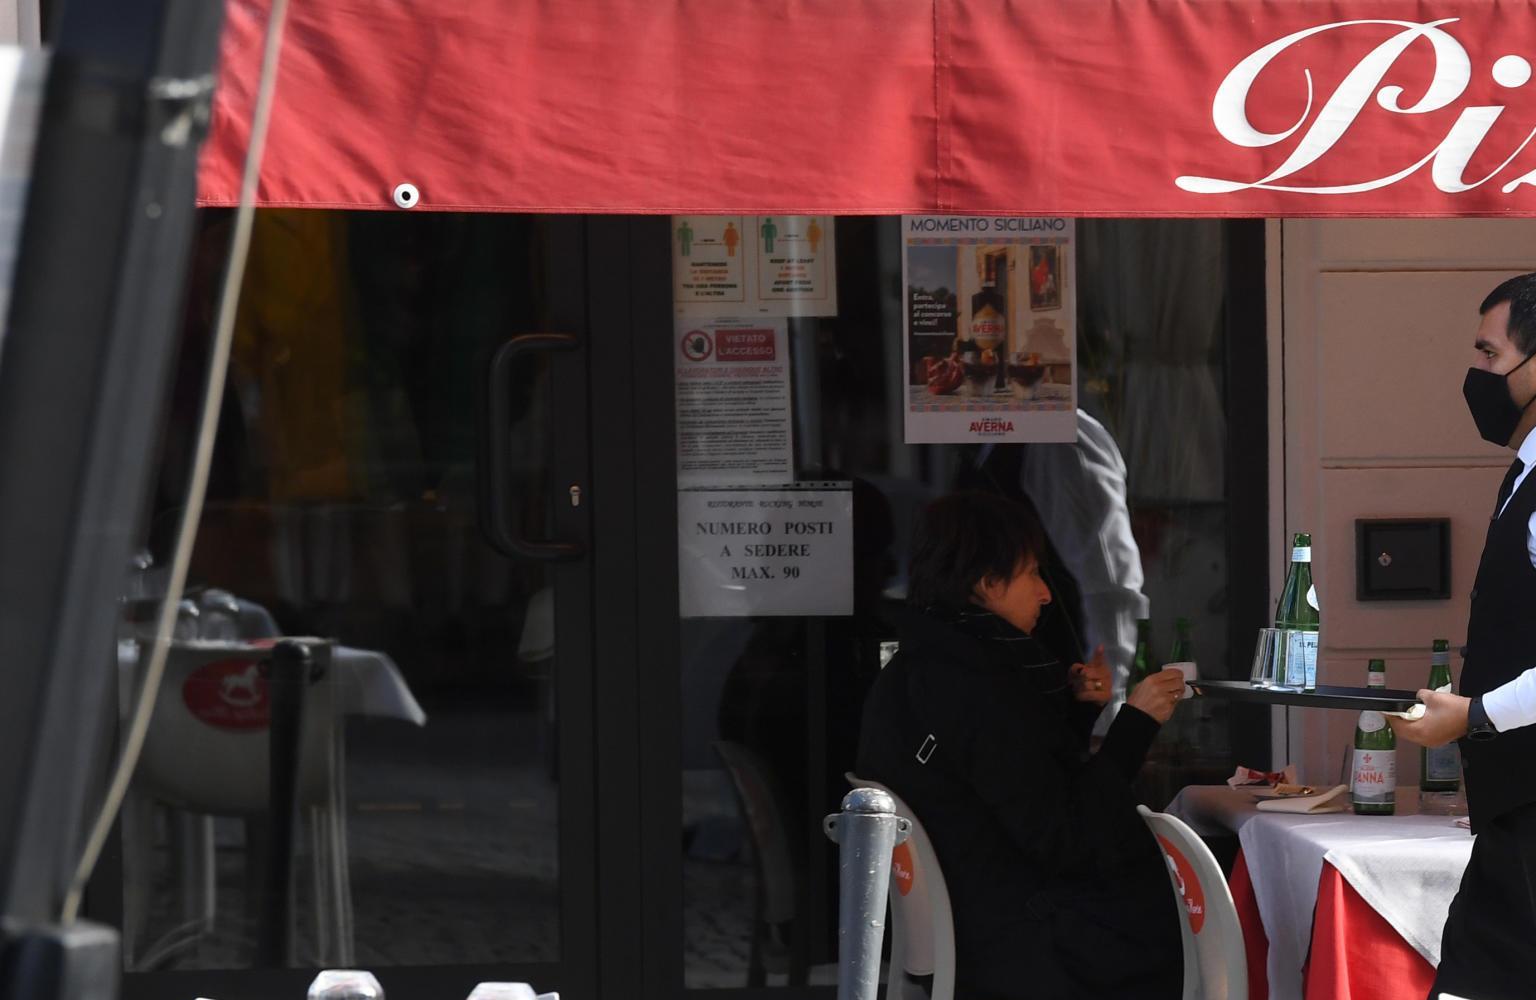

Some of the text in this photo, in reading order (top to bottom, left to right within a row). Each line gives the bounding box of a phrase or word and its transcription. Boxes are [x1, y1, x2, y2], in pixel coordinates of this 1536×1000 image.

[911, 218, 1066, 232] MOMENTO SICILIANO
[725, 334, 766, 343] VIETATO
[969, 421, 1015, 432] AVERNA
[696, 521, 833, 535] NUMERO POSTI
[720, 544, 811, 557] A SEDERE
[731, 566, 800, 579] MAX. 90
